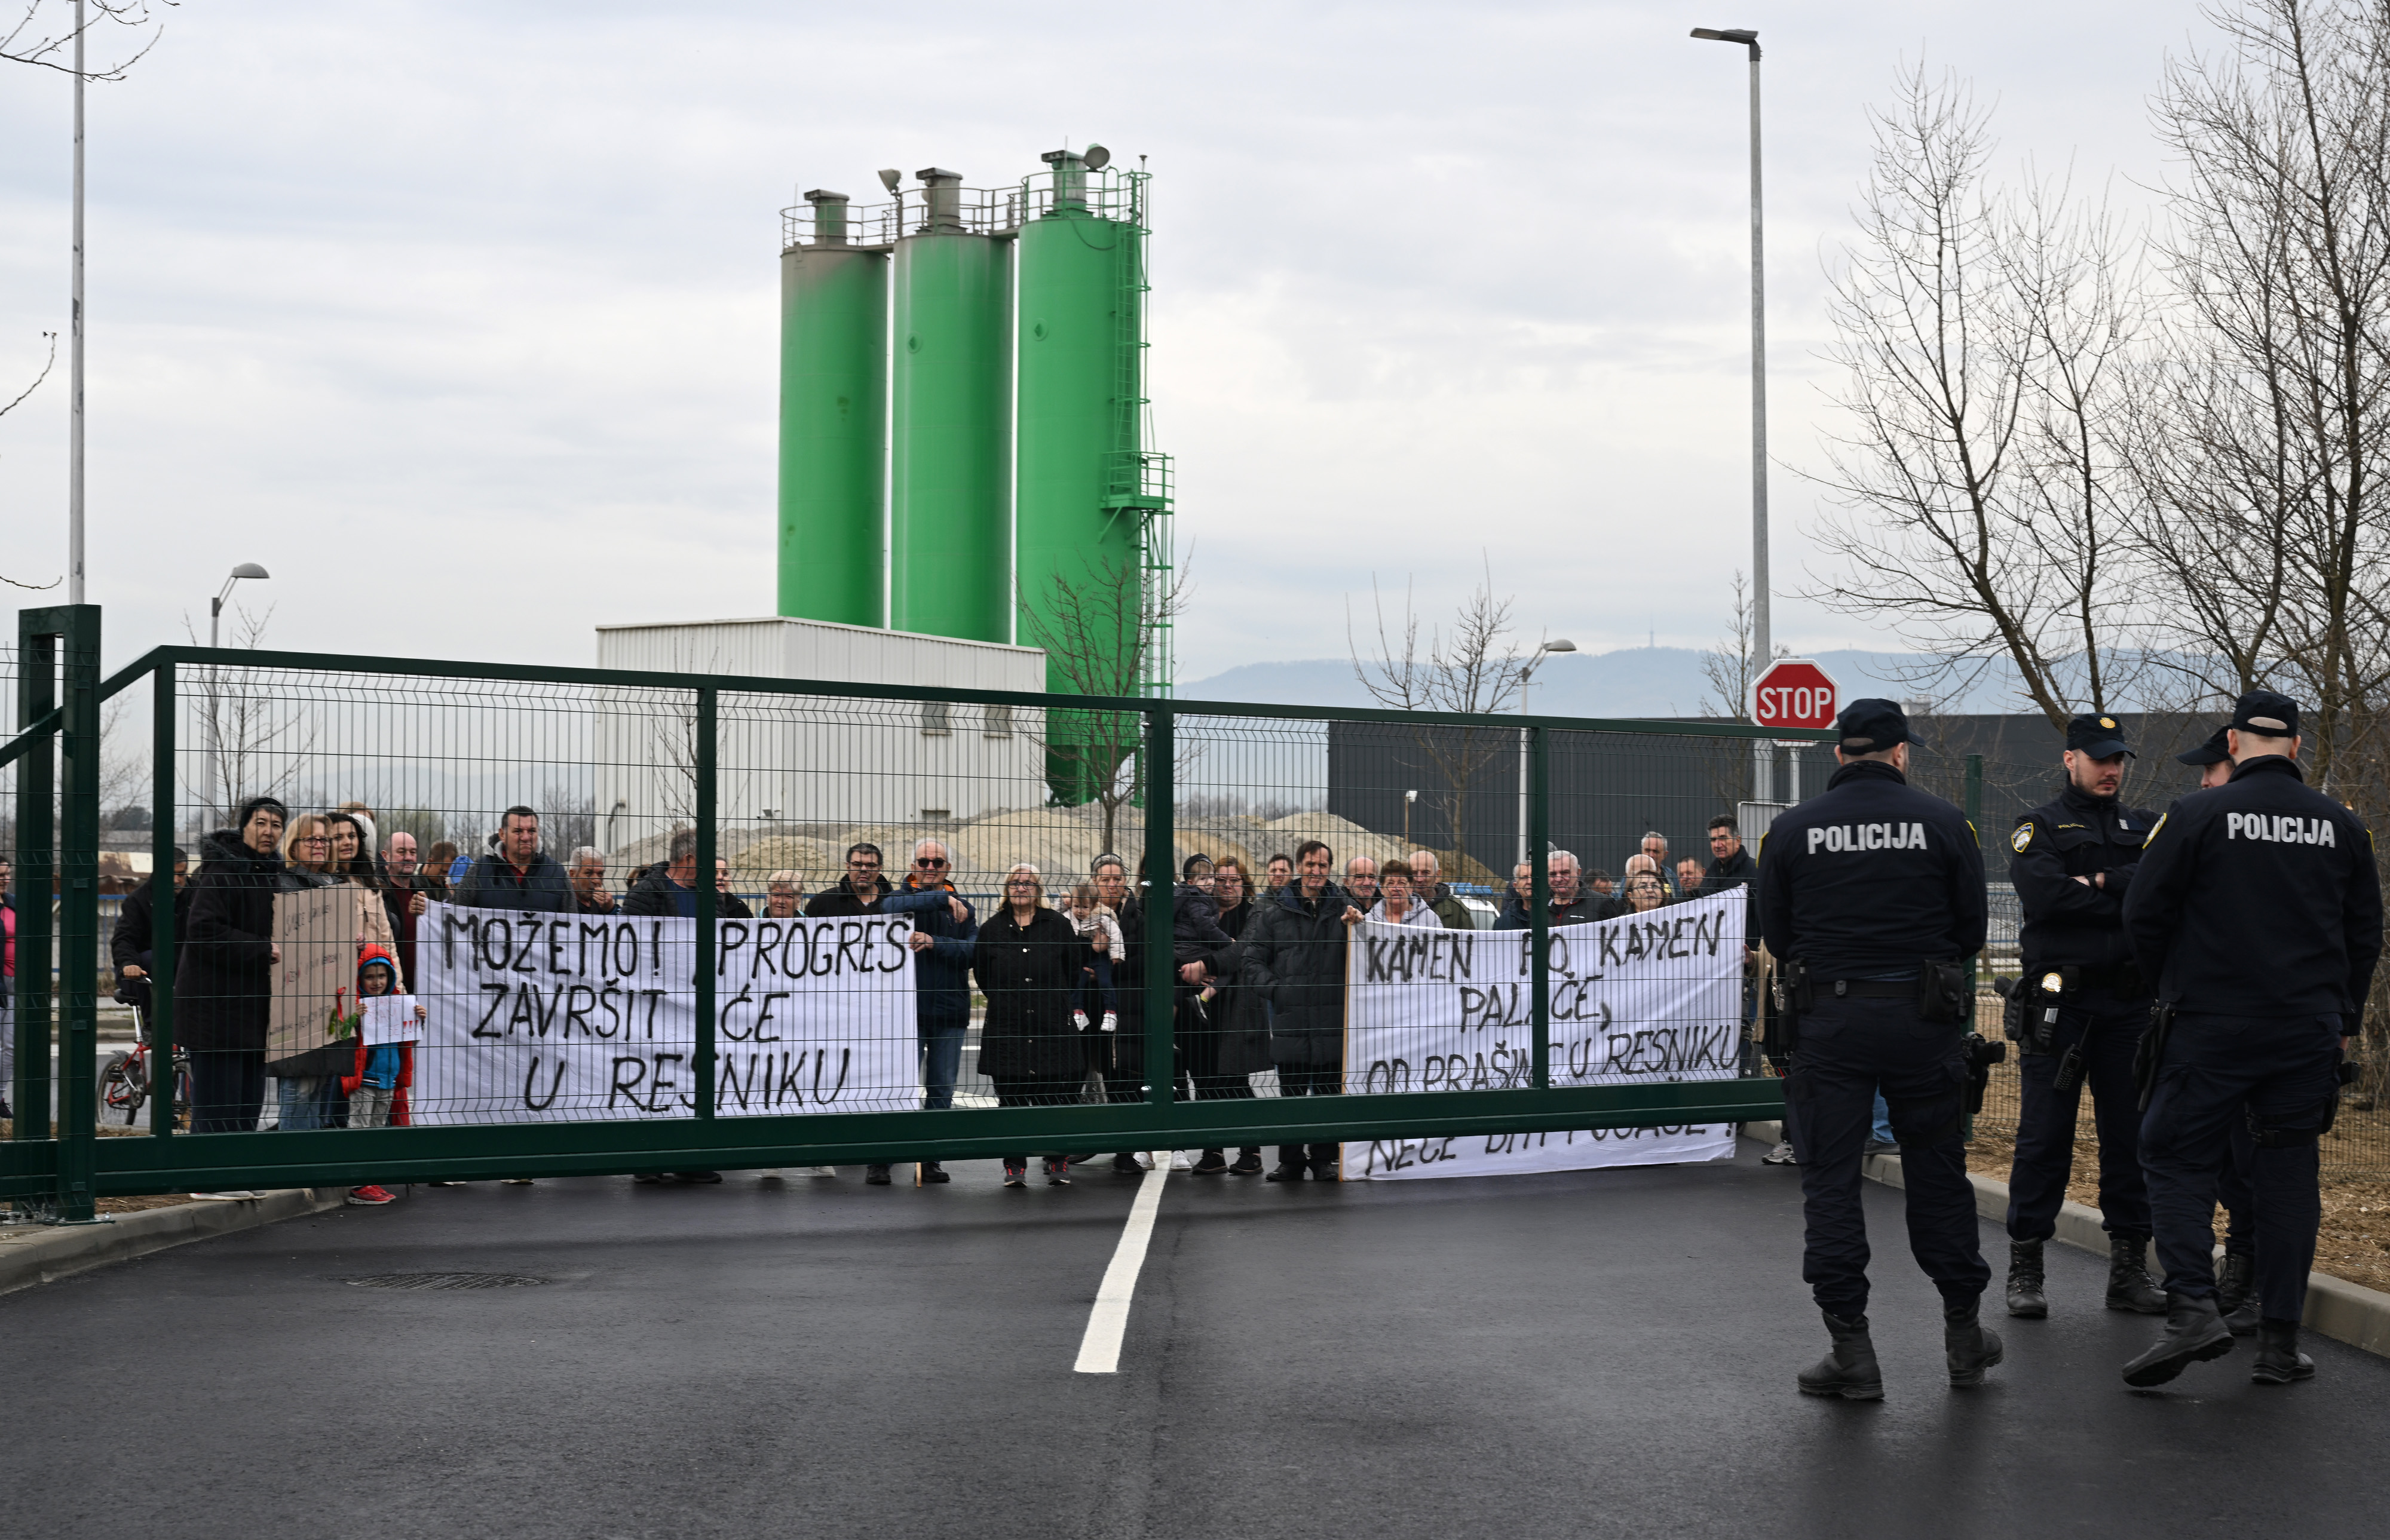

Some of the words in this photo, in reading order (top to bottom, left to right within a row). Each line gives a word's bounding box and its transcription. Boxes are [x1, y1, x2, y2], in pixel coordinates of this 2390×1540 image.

[1760, 687, 1832, 719] STOP
[1807, 822, 1928, 854] POLICIJA
[2227, 812, 2336, 848] POLICIJA
[718, 921, 910, 979] PROGRES
[1368, 932, 1474, 983] KAMEN
[1600, 910, 1725, 966] KAMEN
[472, 977, 667, 1041] ZAVRŠIT
[721, 983, 790, 1042] ĆE
[1460, 972, 1611, 1033] PALČE,
[1570, 1038, 1592, 1078] U
[1601, 1024, 1740, 1075] RESNIKU
[525, 1056, 565, 1110] U
